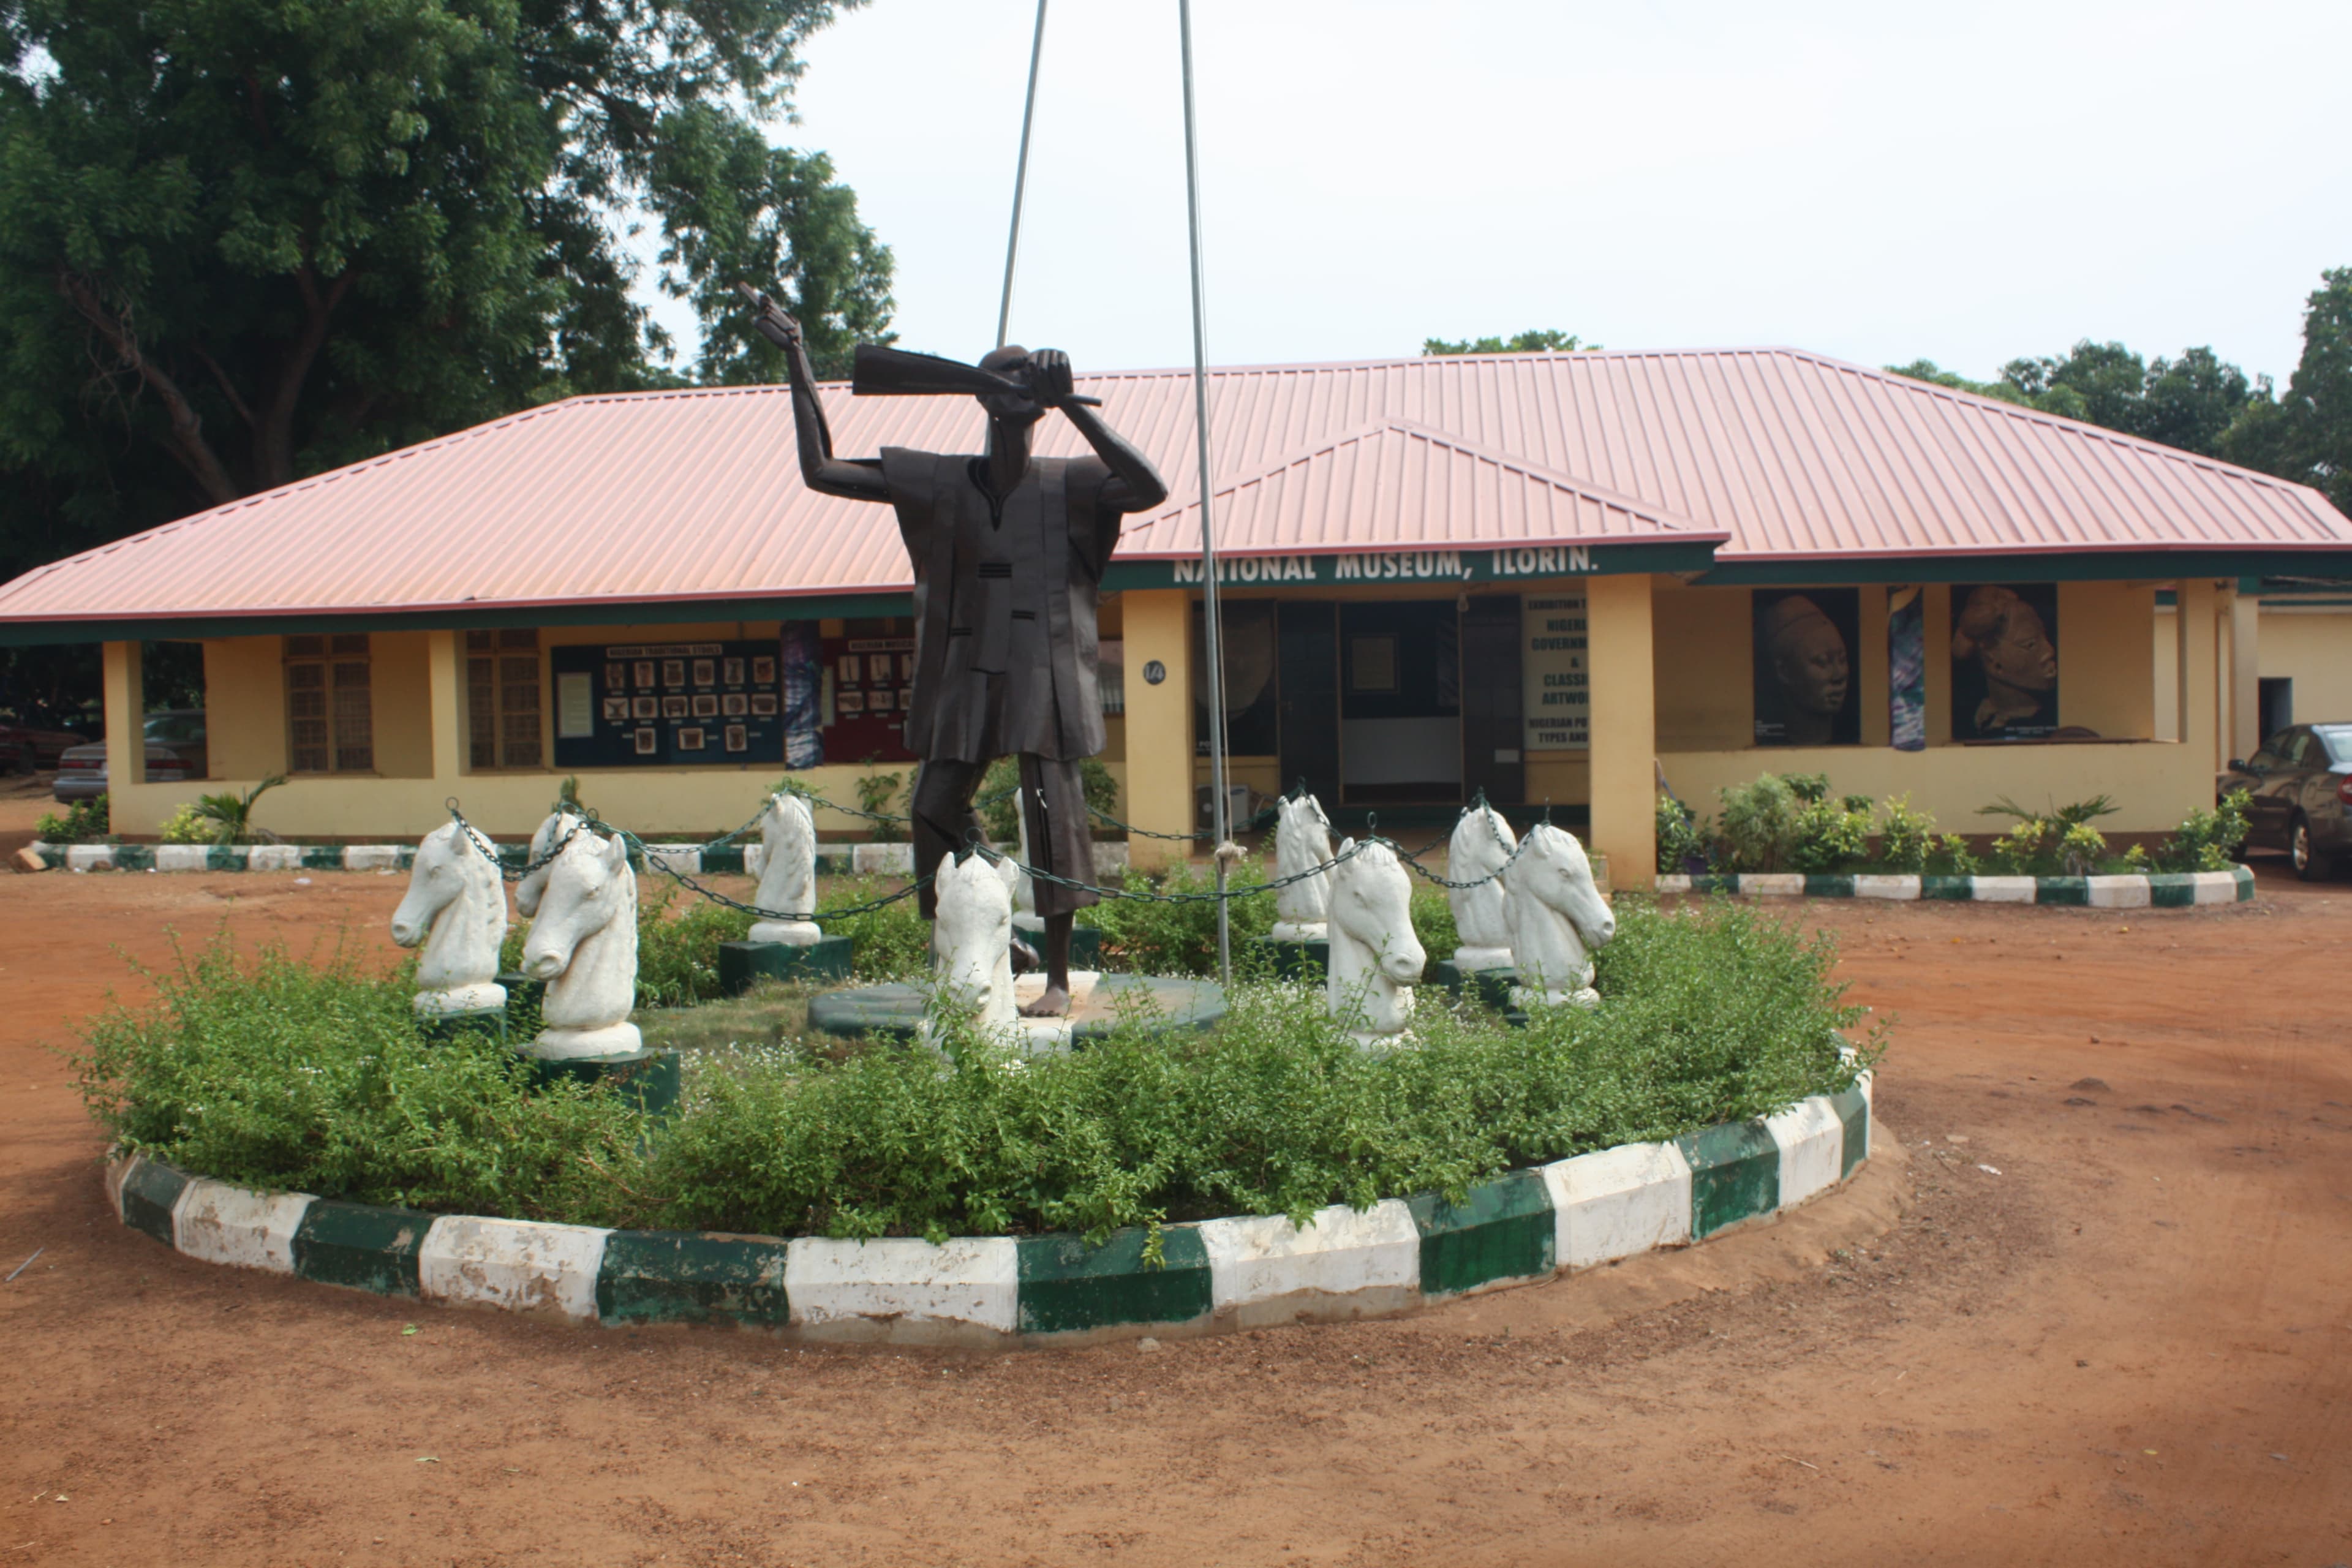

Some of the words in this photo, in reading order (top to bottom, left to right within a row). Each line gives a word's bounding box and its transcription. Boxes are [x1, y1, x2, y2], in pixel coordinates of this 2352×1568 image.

[1174, 556, 1316, 582] NATIONAL
[1335, 551, 1472, 579] MUSEUM,
[1493, 545, 1598, 574] ILORIN.
[1547, 618, 1588, 632] NIGERI
[1532, 637, 1588, 650] GOVERNM
[1544, 673, 1588, 687] CLASSI
[1542, 692, 1589, 705] ARTWO
[1529, 717, 1573, 728] NIGERIAN
[1539, 732, 1567, 743] TYPES
